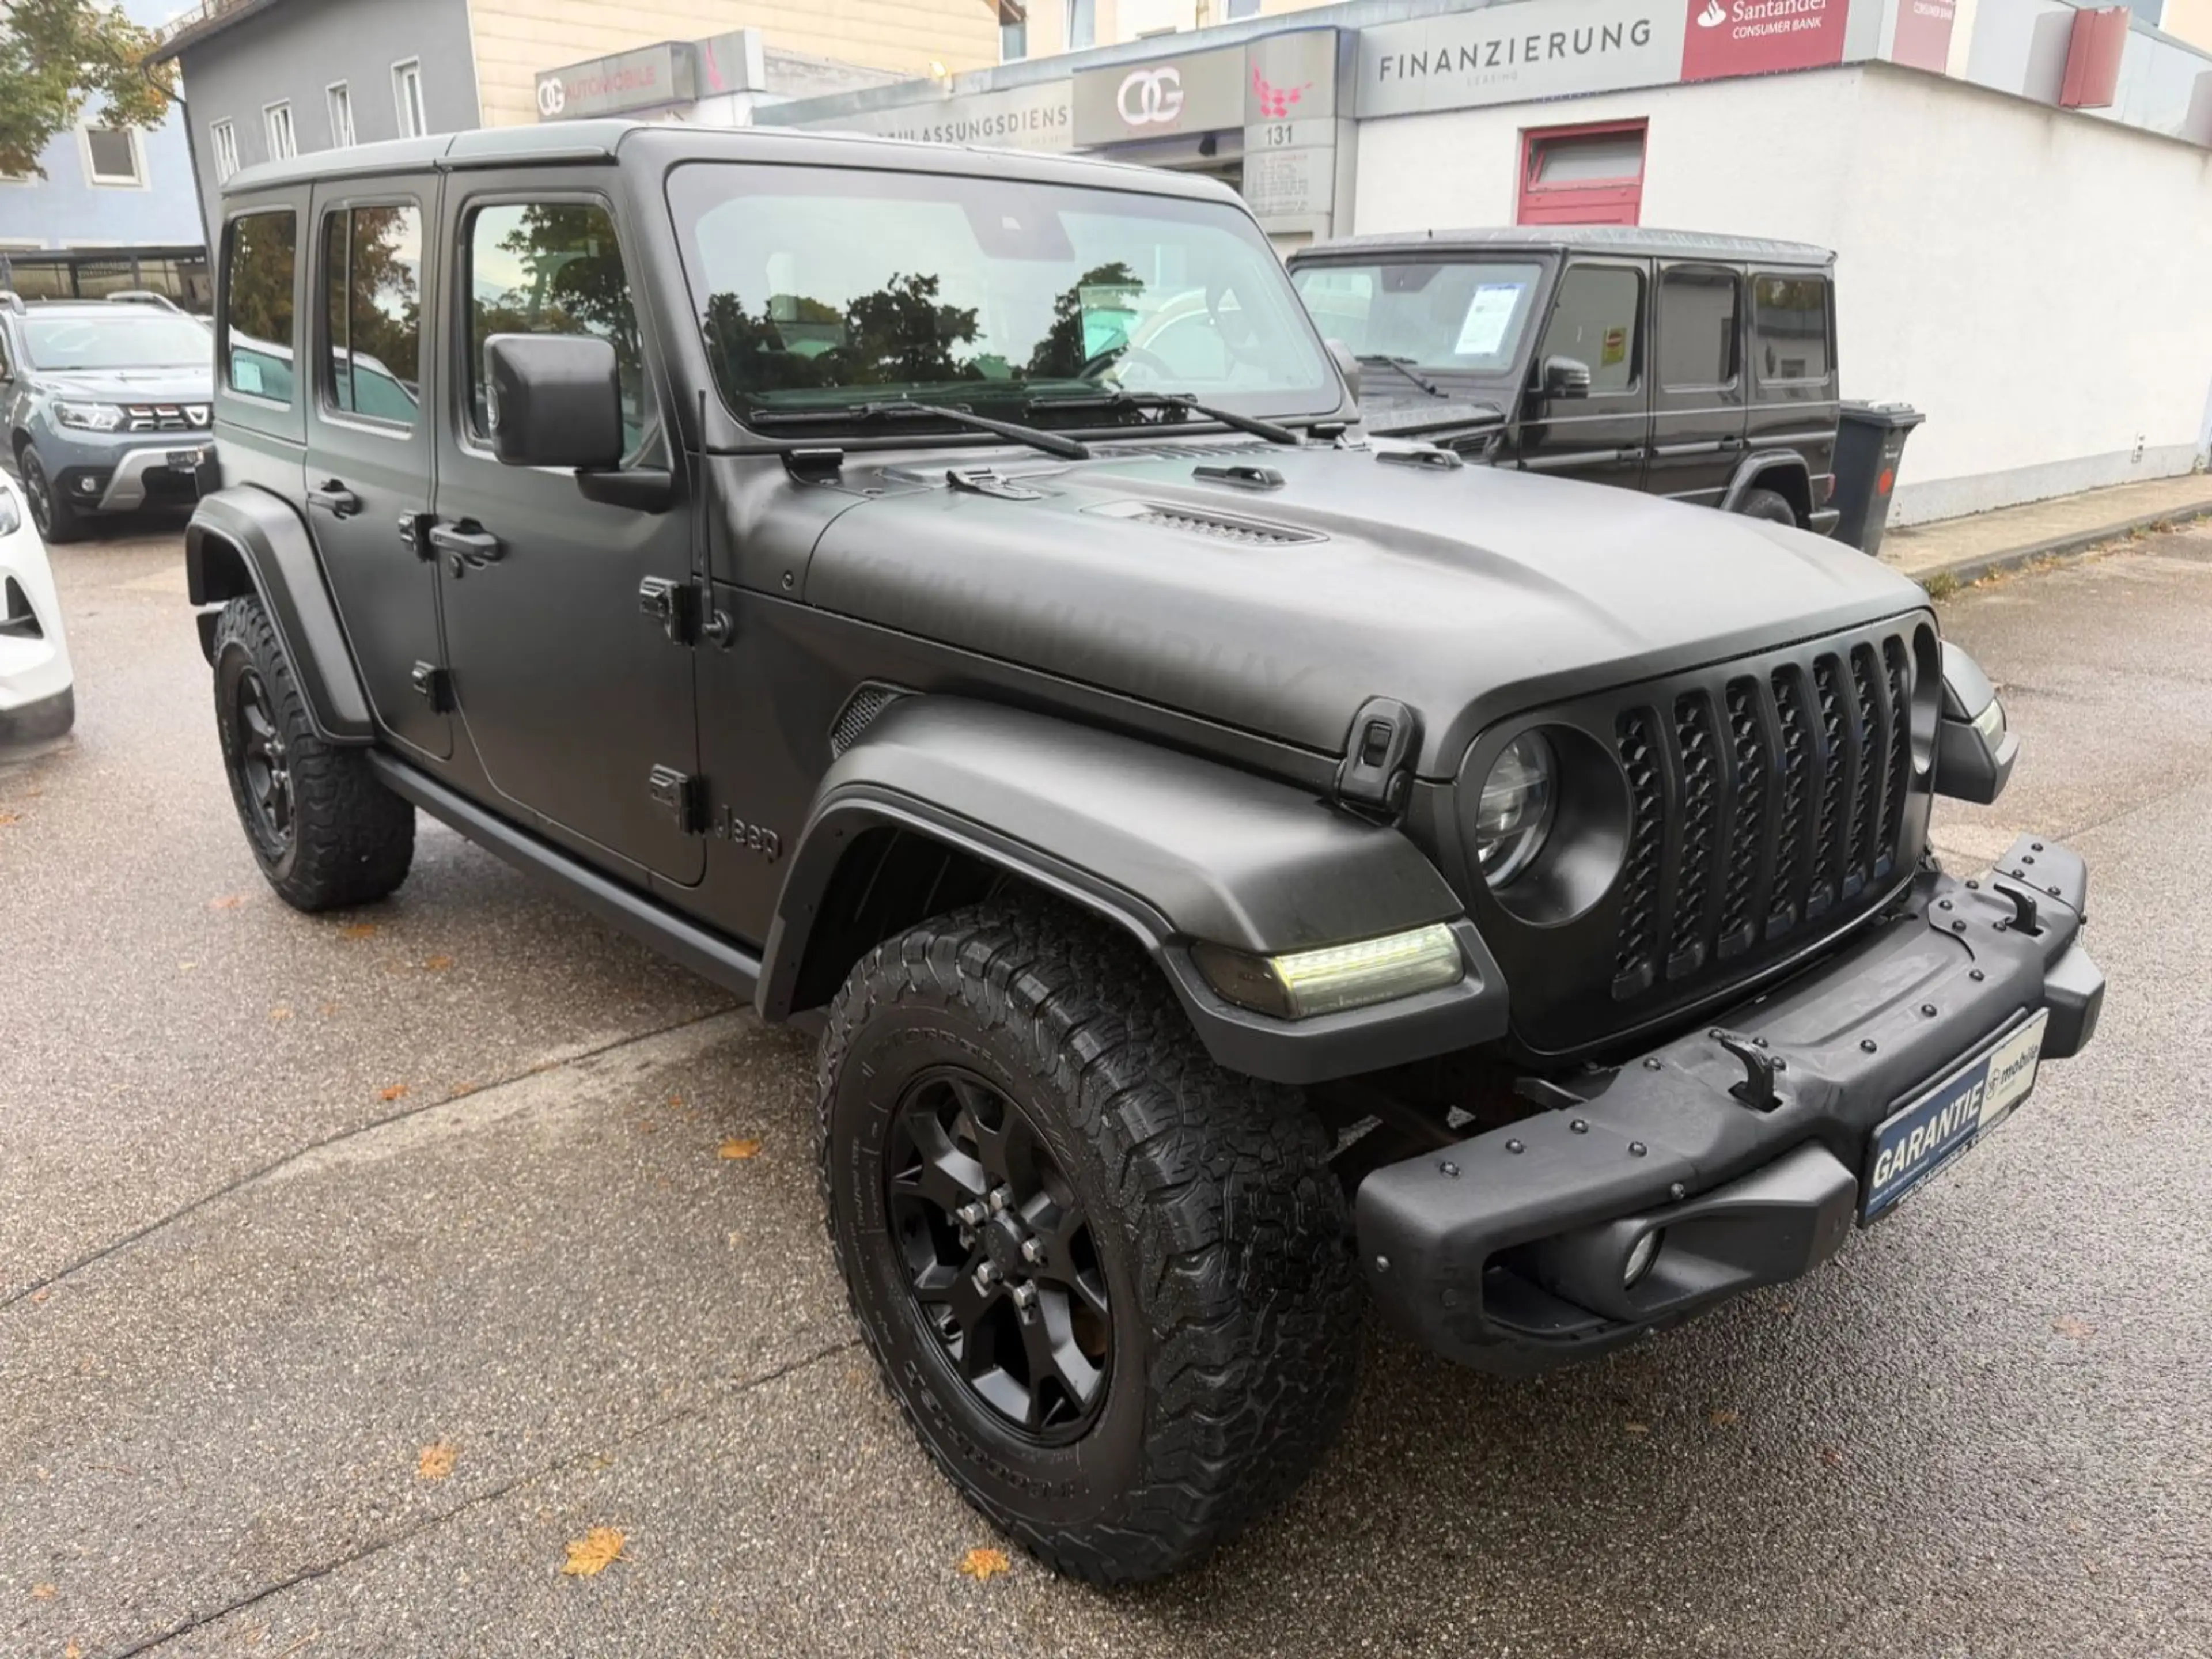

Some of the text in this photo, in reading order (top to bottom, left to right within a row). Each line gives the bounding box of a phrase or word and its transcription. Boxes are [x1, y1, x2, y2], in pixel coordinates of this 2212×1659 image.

[1379, 19, 1652, 81] FINANZIERUNG
[1733, 16, 1822, 39] CONSUMER BANK
[1267, 124, 1293, 145] 131
[714, 804, 781, 862] Jeep
[1873, 1079, 1984, 1188] GARANTIE
